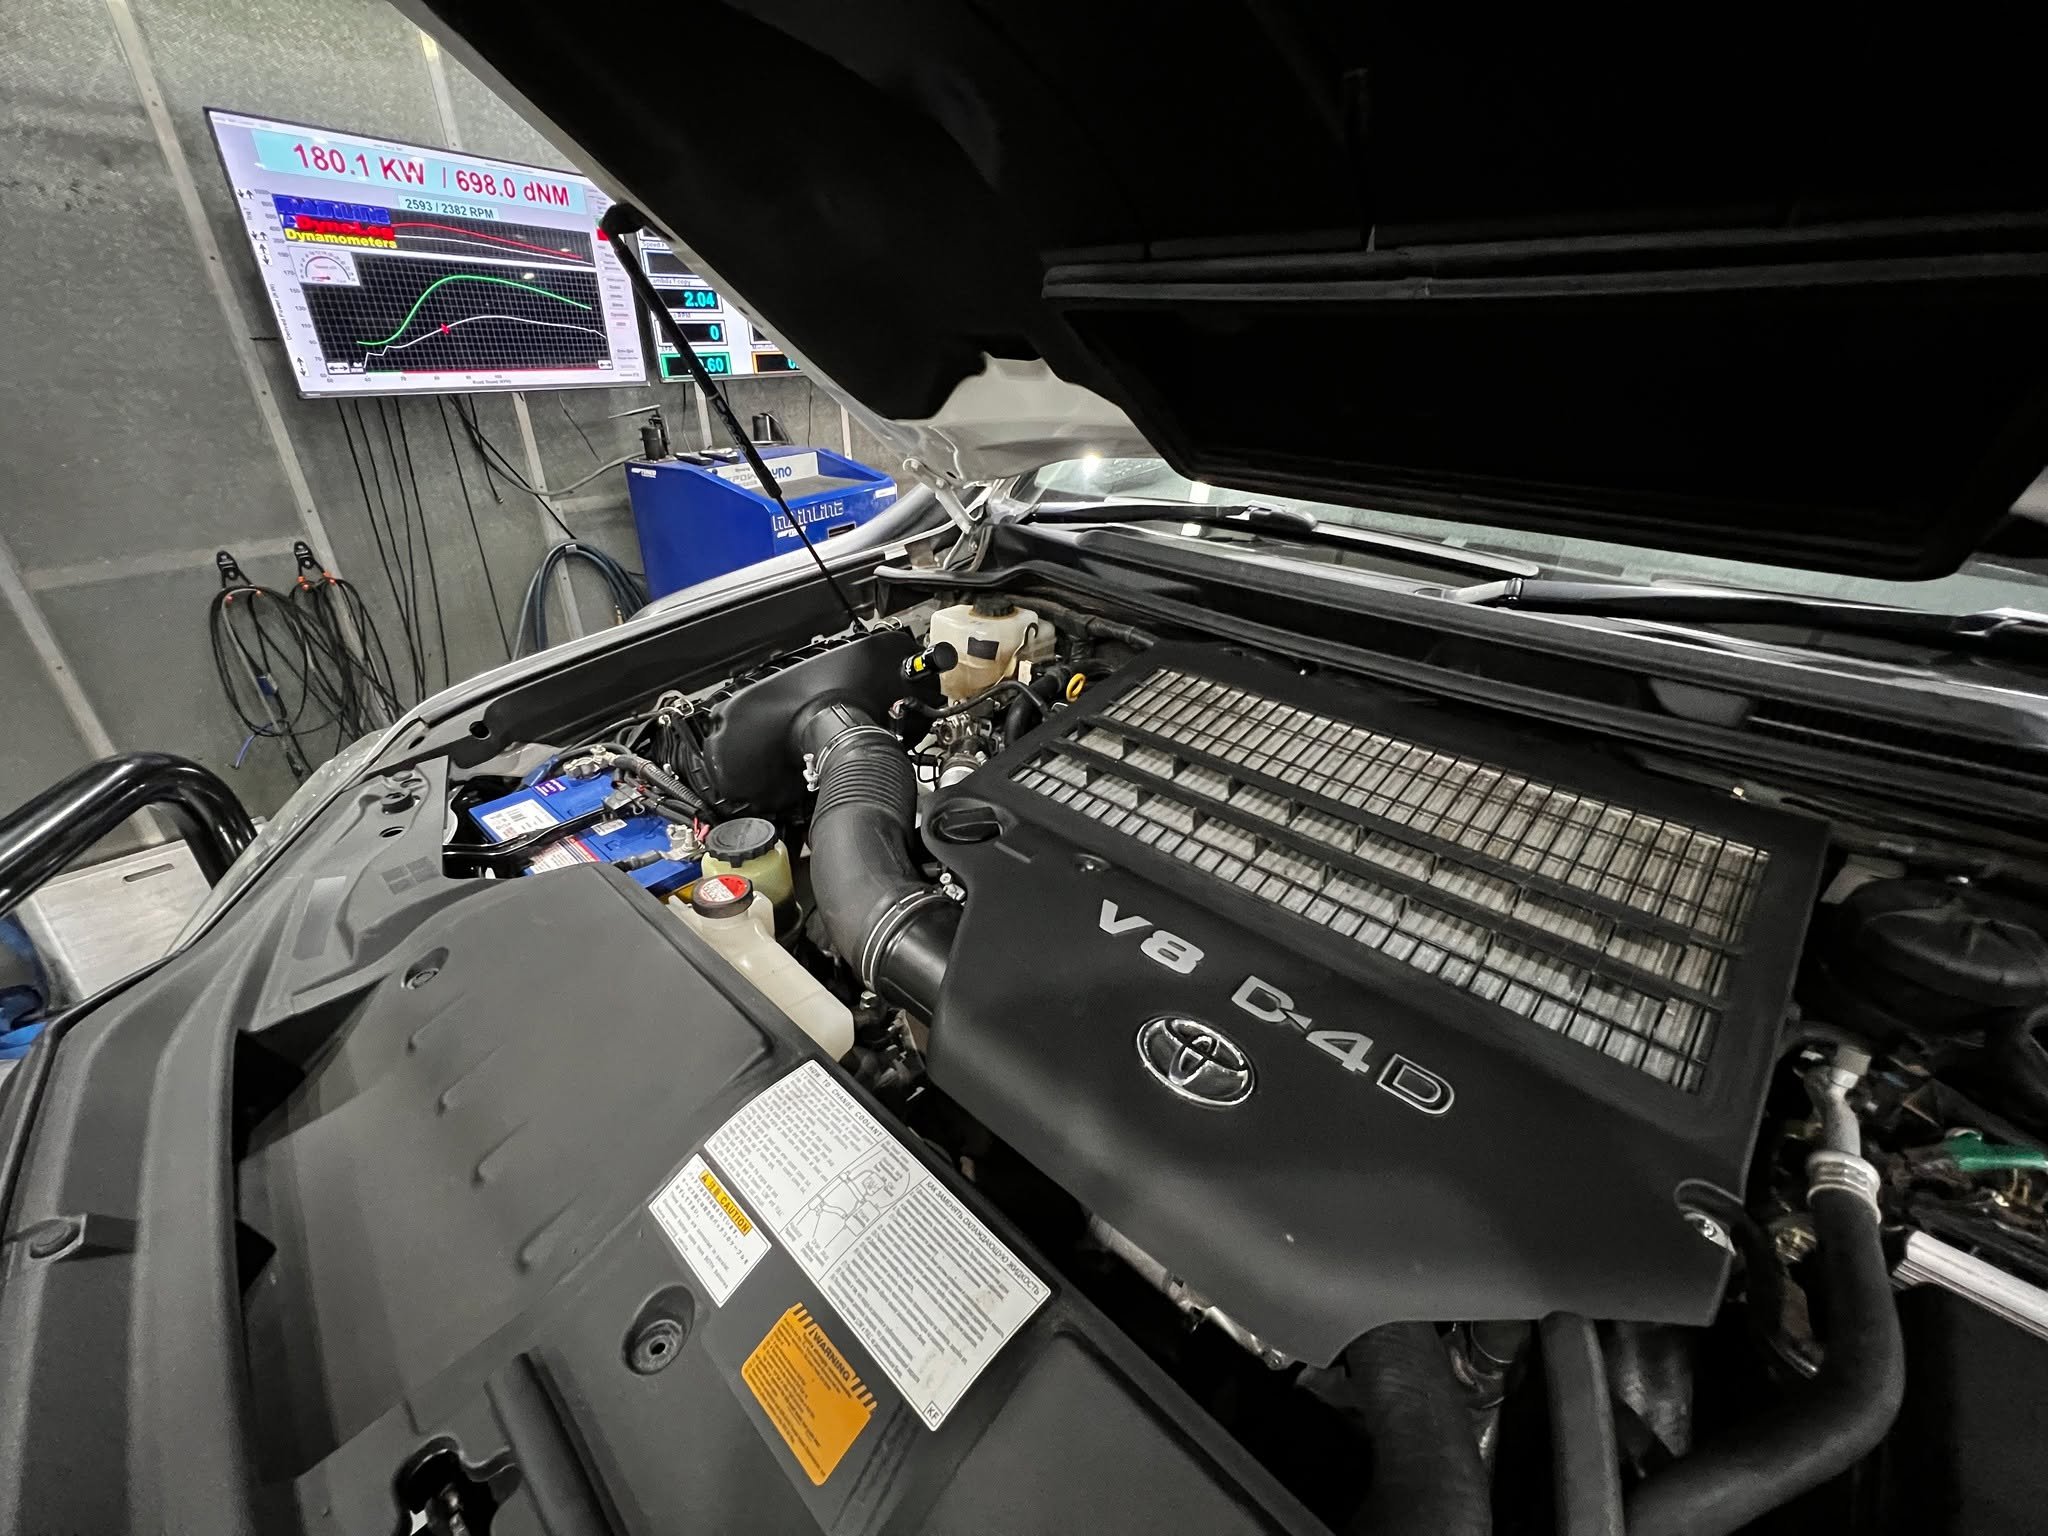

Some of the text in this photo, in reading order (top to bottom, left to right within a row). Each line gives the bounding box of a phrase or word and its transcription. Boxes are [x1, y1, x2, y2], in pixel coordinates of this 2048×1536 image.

[293, 143, 370, 177] 180.1
[379, 156, 425, 185] KW
[456, 169, 516, 199] 698.0
[523, 181, 570, 207] dNM
[405, 198, 433, 213] 2593
[441, 203, 467, 217] 2382
[470, 207, 495, 220] RPM
[284, 228, 397, 249] Dynamometers
[684, 291, 715, 307] 2.04
[709, 325, 720, 341] 0
[1099, 898, 1206, 976] V8
[807, 1064, 821, 1078] HOW
[854, 1110, 882, 1138] COOLANT
[720, 1196, 749, 1233] CAUTION
[812, 1330, 850, 1382] WARNING
[926, 1404, 940, 1421] KF
